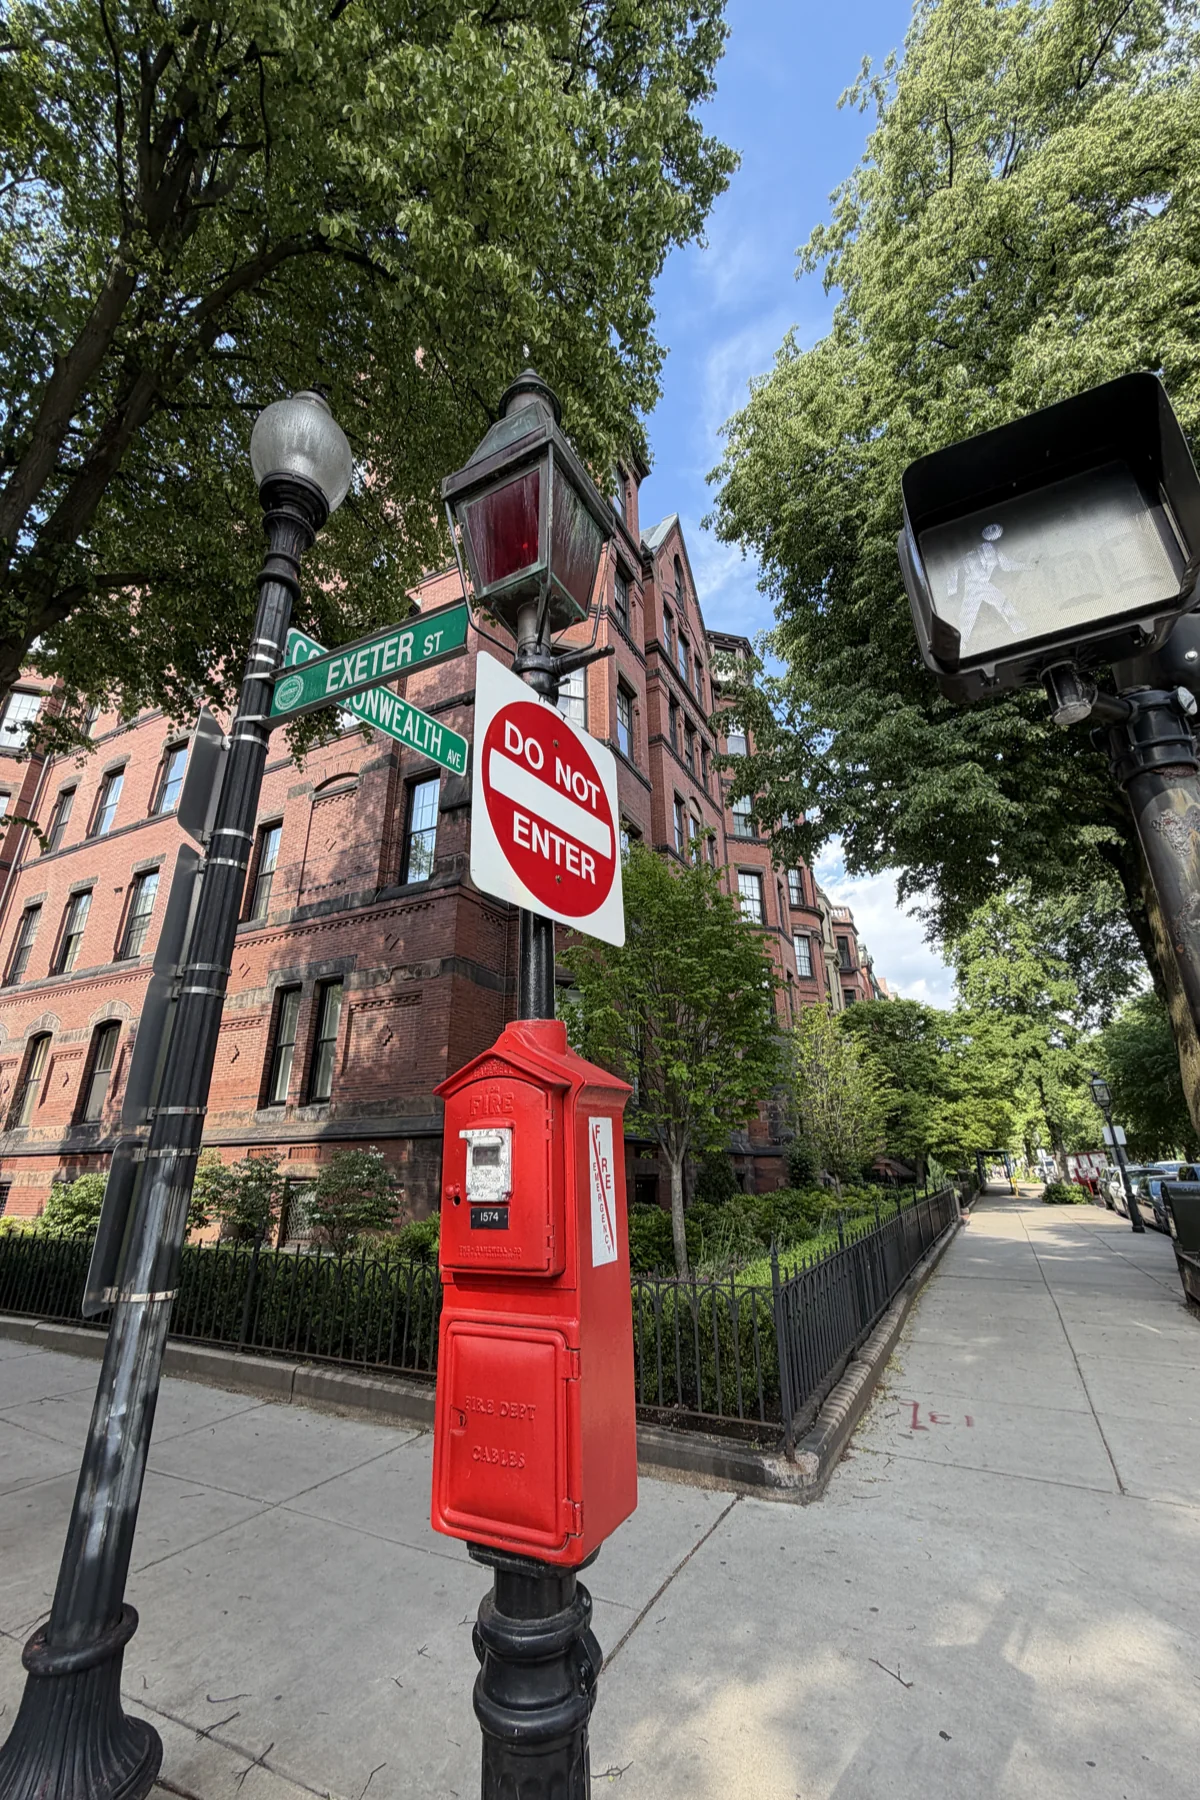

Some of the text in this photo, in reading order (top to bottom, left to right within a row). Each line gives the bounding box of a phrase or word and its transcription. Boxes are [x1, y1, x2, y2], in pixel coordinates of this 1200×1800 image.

[325, 631, 414, 694] EXETER
[423, 631, 444, 656] ST
[446, 748, 462, 769] AVE
[505, 719, 600, 810] DO NOT
[513, 810, 596, 886] ENTER
[470, 1092, 515, 1116] FIRE
[594, 1124, 611, 1190] FIRE
[480, 1211, 499, 1222] 1574
[465, 1395, 537, 1420] FIRE DEPT
[472, 1445, 526, 1469] CABLES
